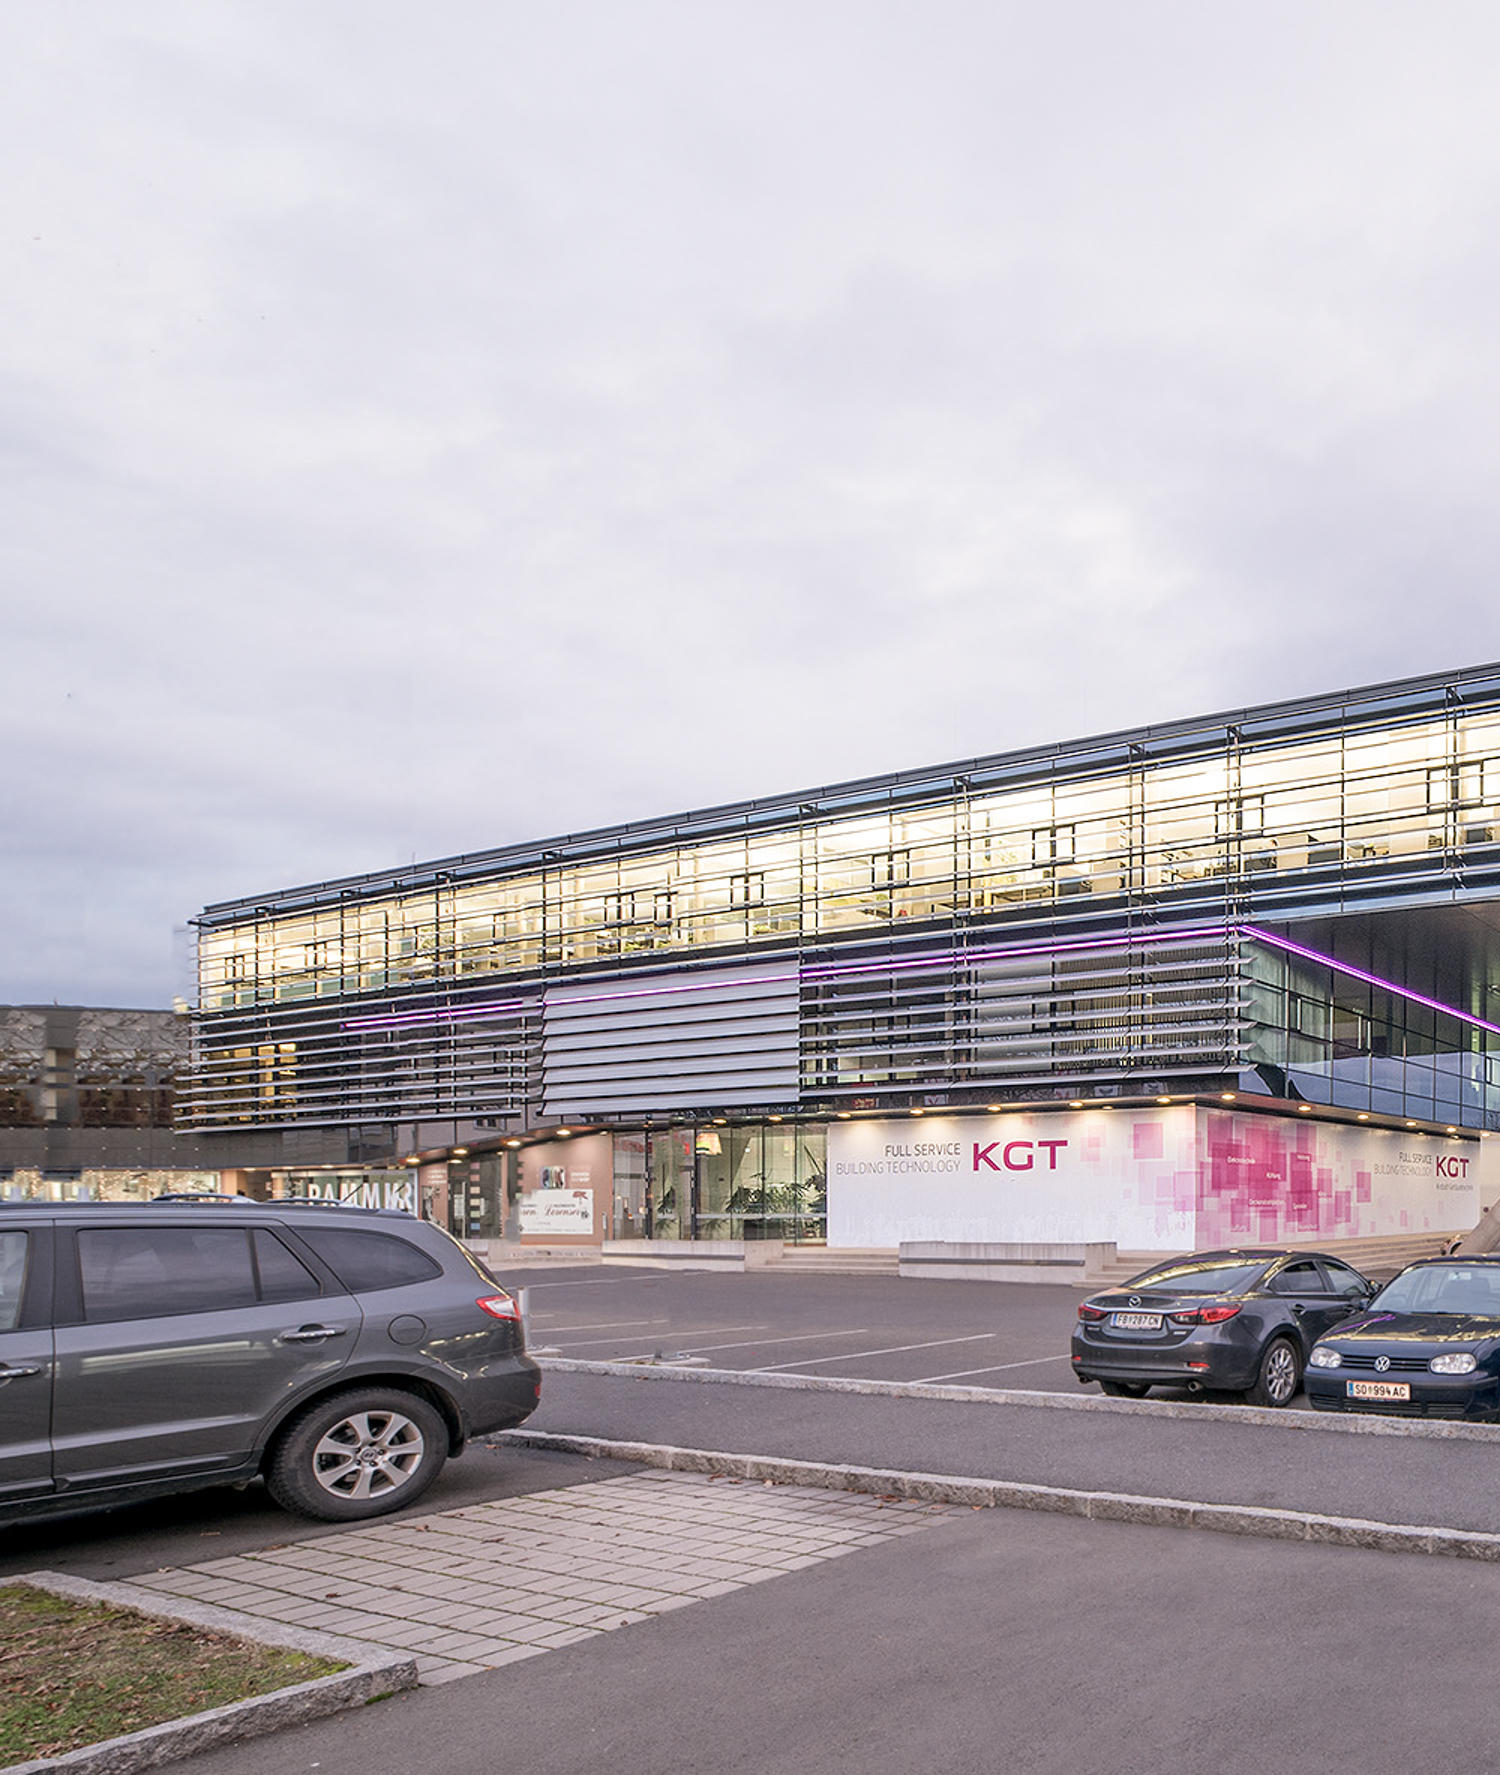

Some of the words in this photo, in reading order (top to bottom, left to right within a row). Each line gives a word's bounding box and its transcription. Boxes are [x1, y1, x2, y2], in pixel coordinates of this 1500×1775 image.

[885, 1144, 912, 1157] FULL
[914, 1143, 961, 1157] SERVICE
[973, 1140, 1068, 1171] KGT
[836, 1161, 884, 1175] BUILDING
[887, 1159, 961, 1174] TECHNOLOGY
[1436, 1155, 1470, 1178] KGT
[1355, 1384, 1367, 1395] SO
[1373, 1385, 1391, 1396] 994
[1392, 1386, 1406, 1397] AC
